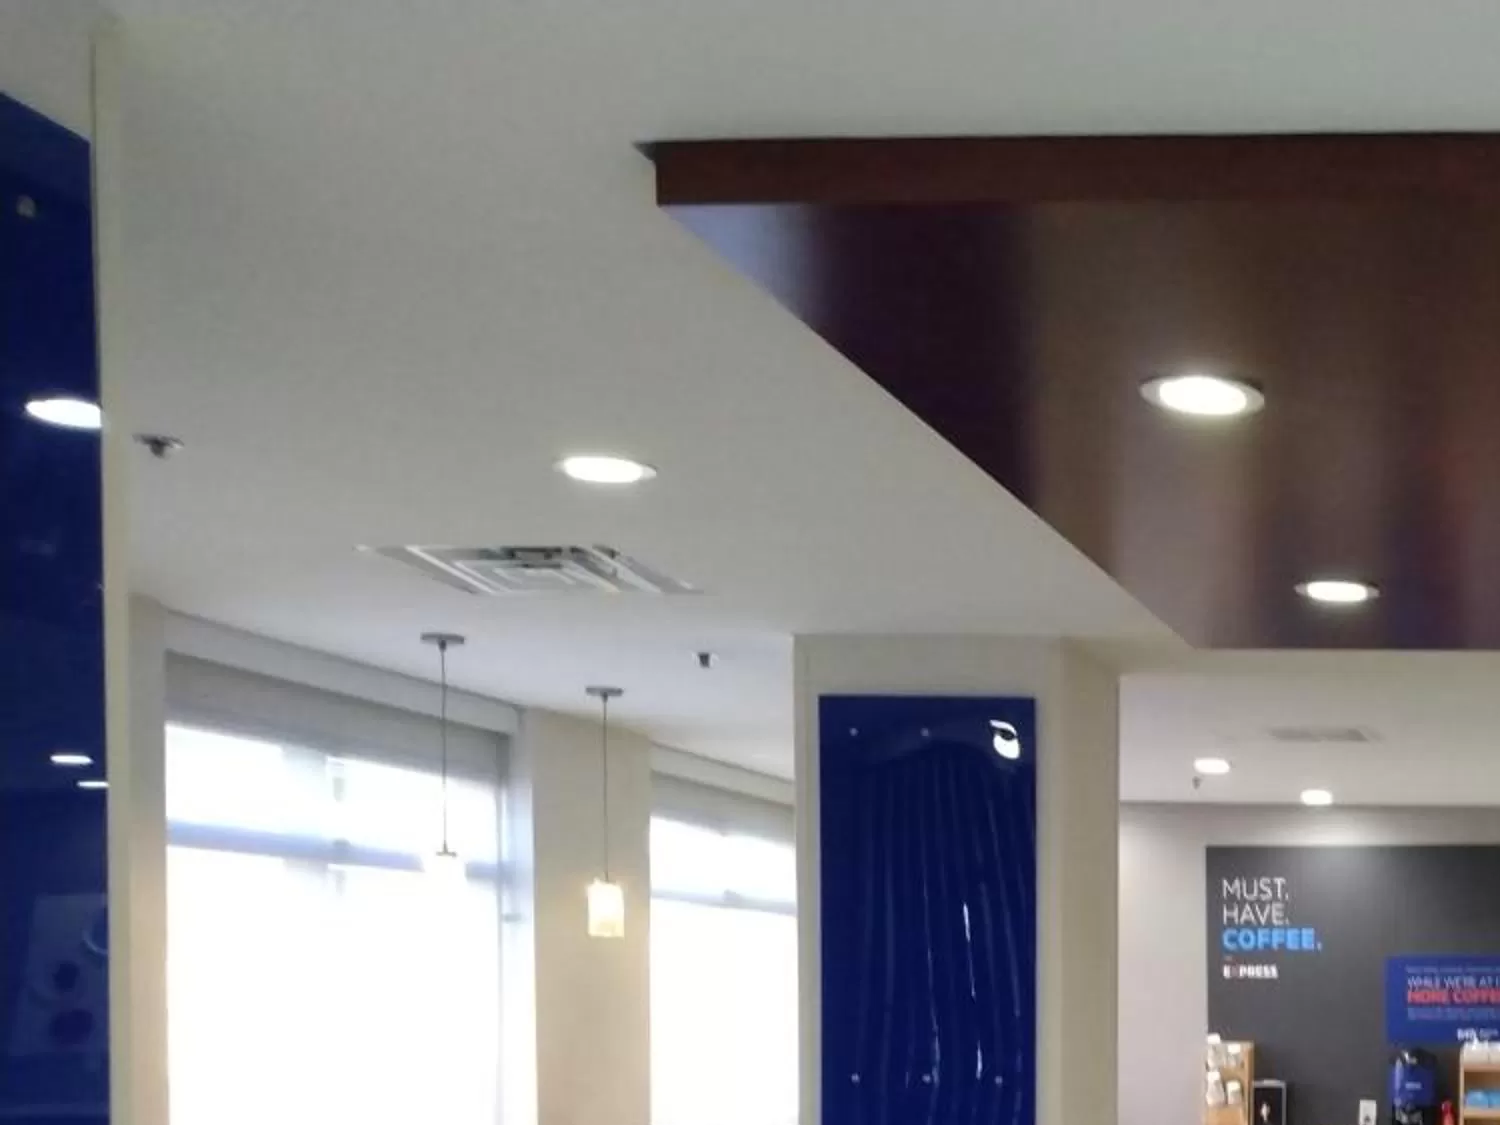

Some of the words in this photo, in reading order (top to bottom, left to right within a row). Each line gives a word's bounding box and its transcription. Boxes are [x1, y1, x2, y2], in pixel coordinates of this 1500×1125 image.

[1223, 877, 1289, 901] MUST.
[1223, 902, 1289, 925] HAVE.
[1223, 927, 1322, 951] COFFEE.
